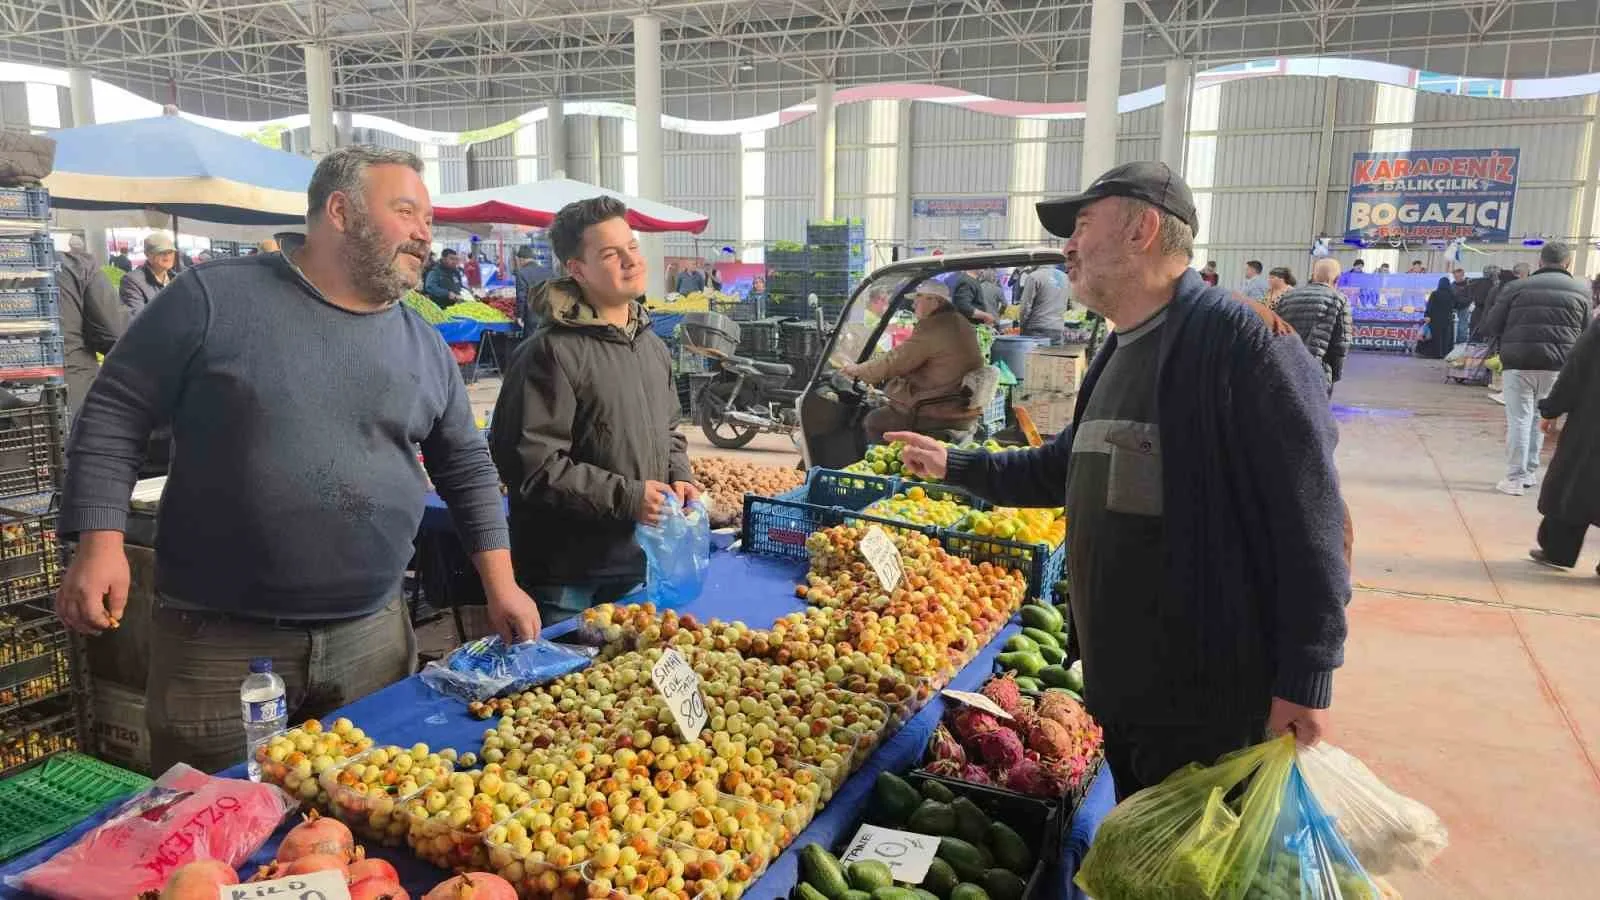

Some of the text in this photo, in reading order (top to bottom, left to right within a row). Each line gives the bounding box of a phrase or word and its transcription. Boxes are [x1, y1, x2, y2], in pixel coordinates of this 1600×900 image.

[1353, 150, 1516, 185] KARADENİZ
[1384, 178, 1479, 192] BALIKÇILIK
[680, 691, 703, 728] 80
[842, 833, 873, 864] TANE
